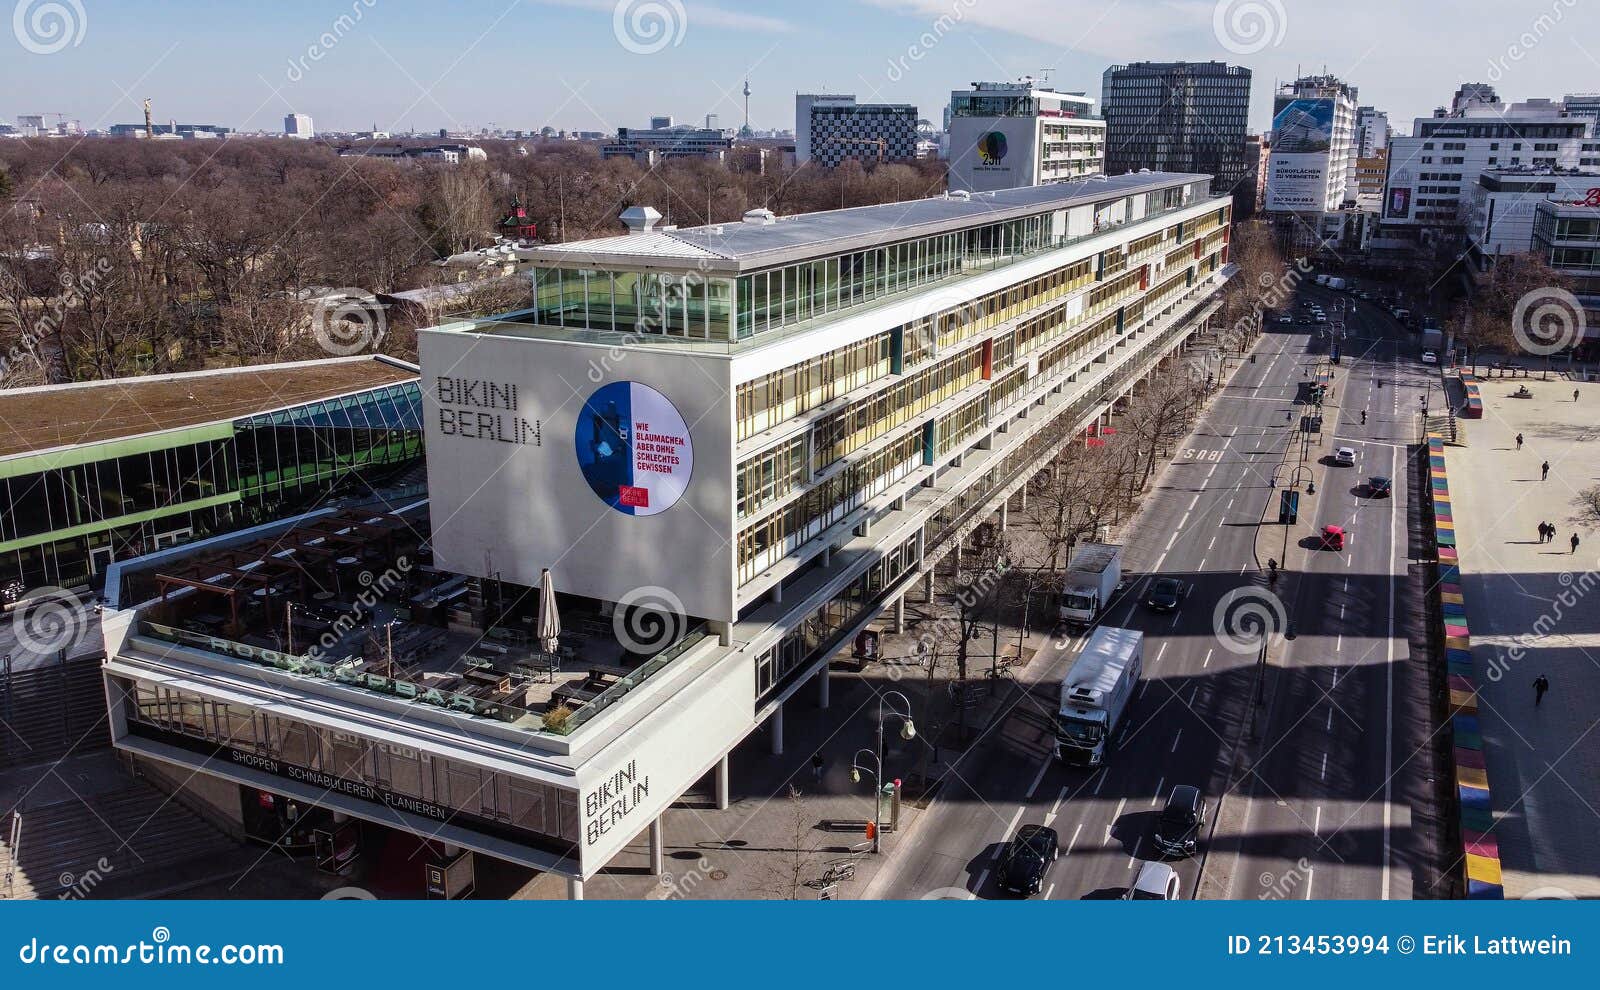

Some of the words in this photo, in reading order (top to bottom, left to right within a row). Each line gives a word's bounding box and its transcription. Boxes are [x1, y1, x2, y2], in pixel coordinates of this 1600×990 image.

[438, 376, 517, 411] BIKINI
[440, 408, 541, 447] BERLIN
[636, 423, 649, 431] WIE
[637, 442, 655, 452] ABER
[656, 444, 675, 454] OHNE
[637, 451, 680, 465] SCHLECHTES
[637, 461, 672, 474] GEWISSEN
[395, 679, 476, 711] BAR
[232, 750, 278, 773] SHOPPEN
[288, 766, 375, 799] SCHNABULIEREN
[385, 793, 446, 819] FLANIEREN
[586, 759, 636, 818] BIKINI
[587, 775, 648, 846] BERLIN
